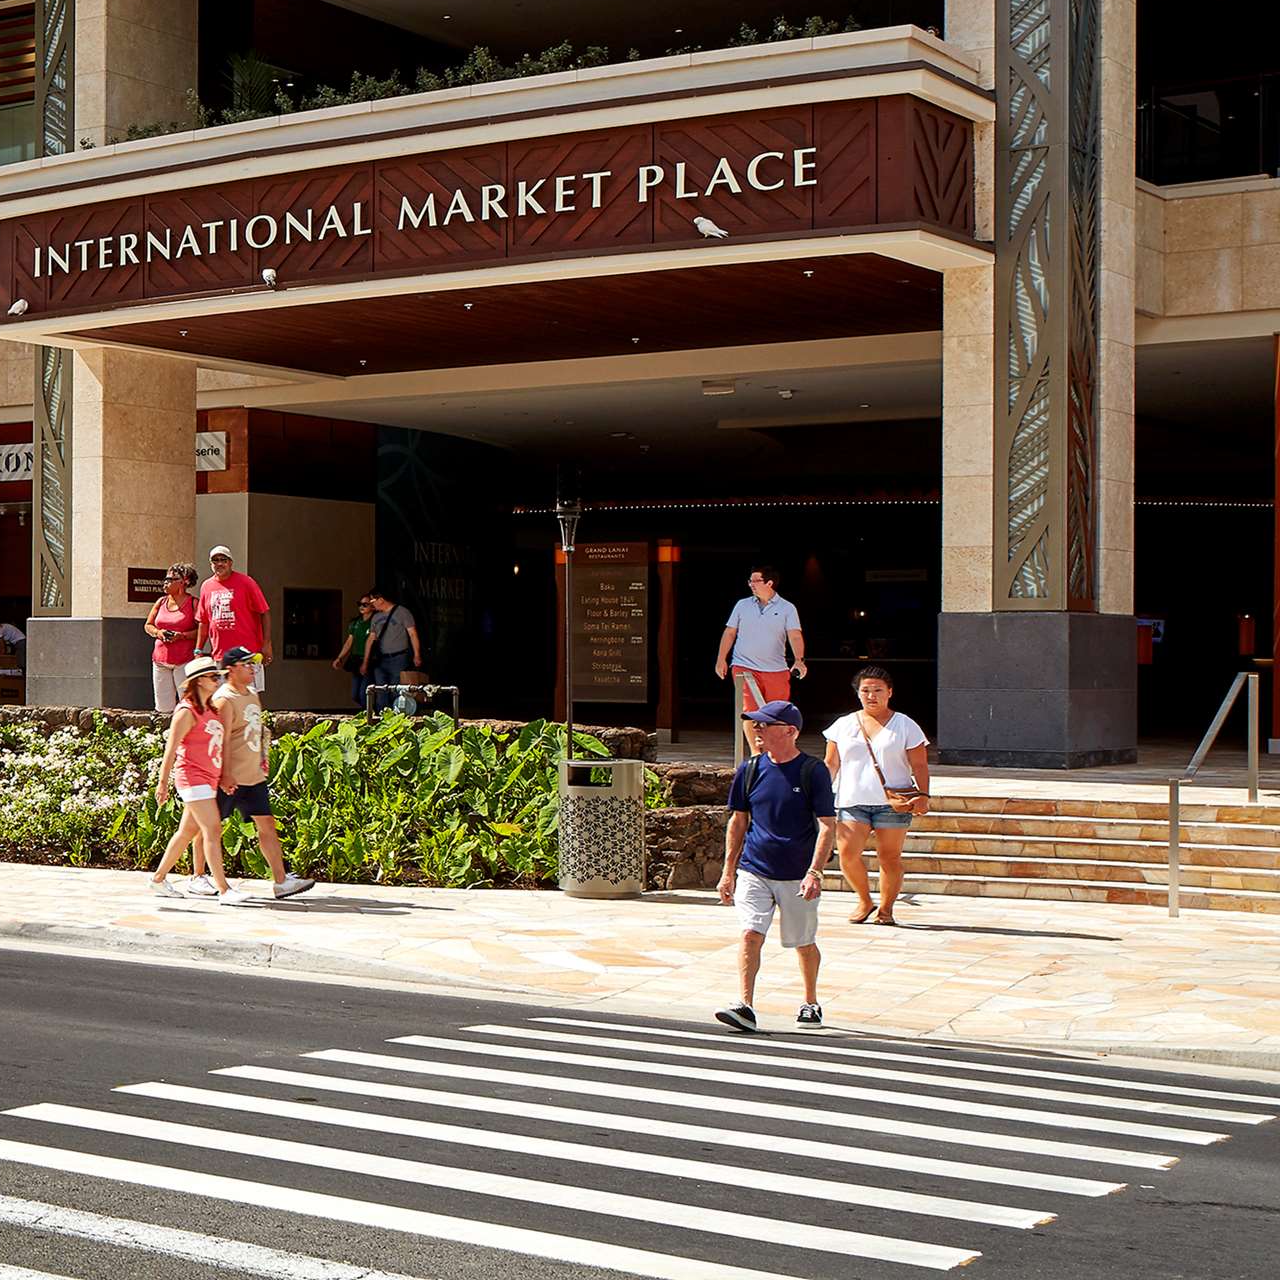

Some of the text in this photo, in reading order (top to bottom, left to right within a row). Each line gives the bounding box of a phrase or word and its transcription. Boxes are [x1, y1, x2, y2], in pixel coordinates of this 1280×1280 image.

[33, 147, 818, 278] INTERNATIONAL MARKET PLACE
[195, 444, 220, 457] serie
[133, 578, 163, 586] INTERNATION
